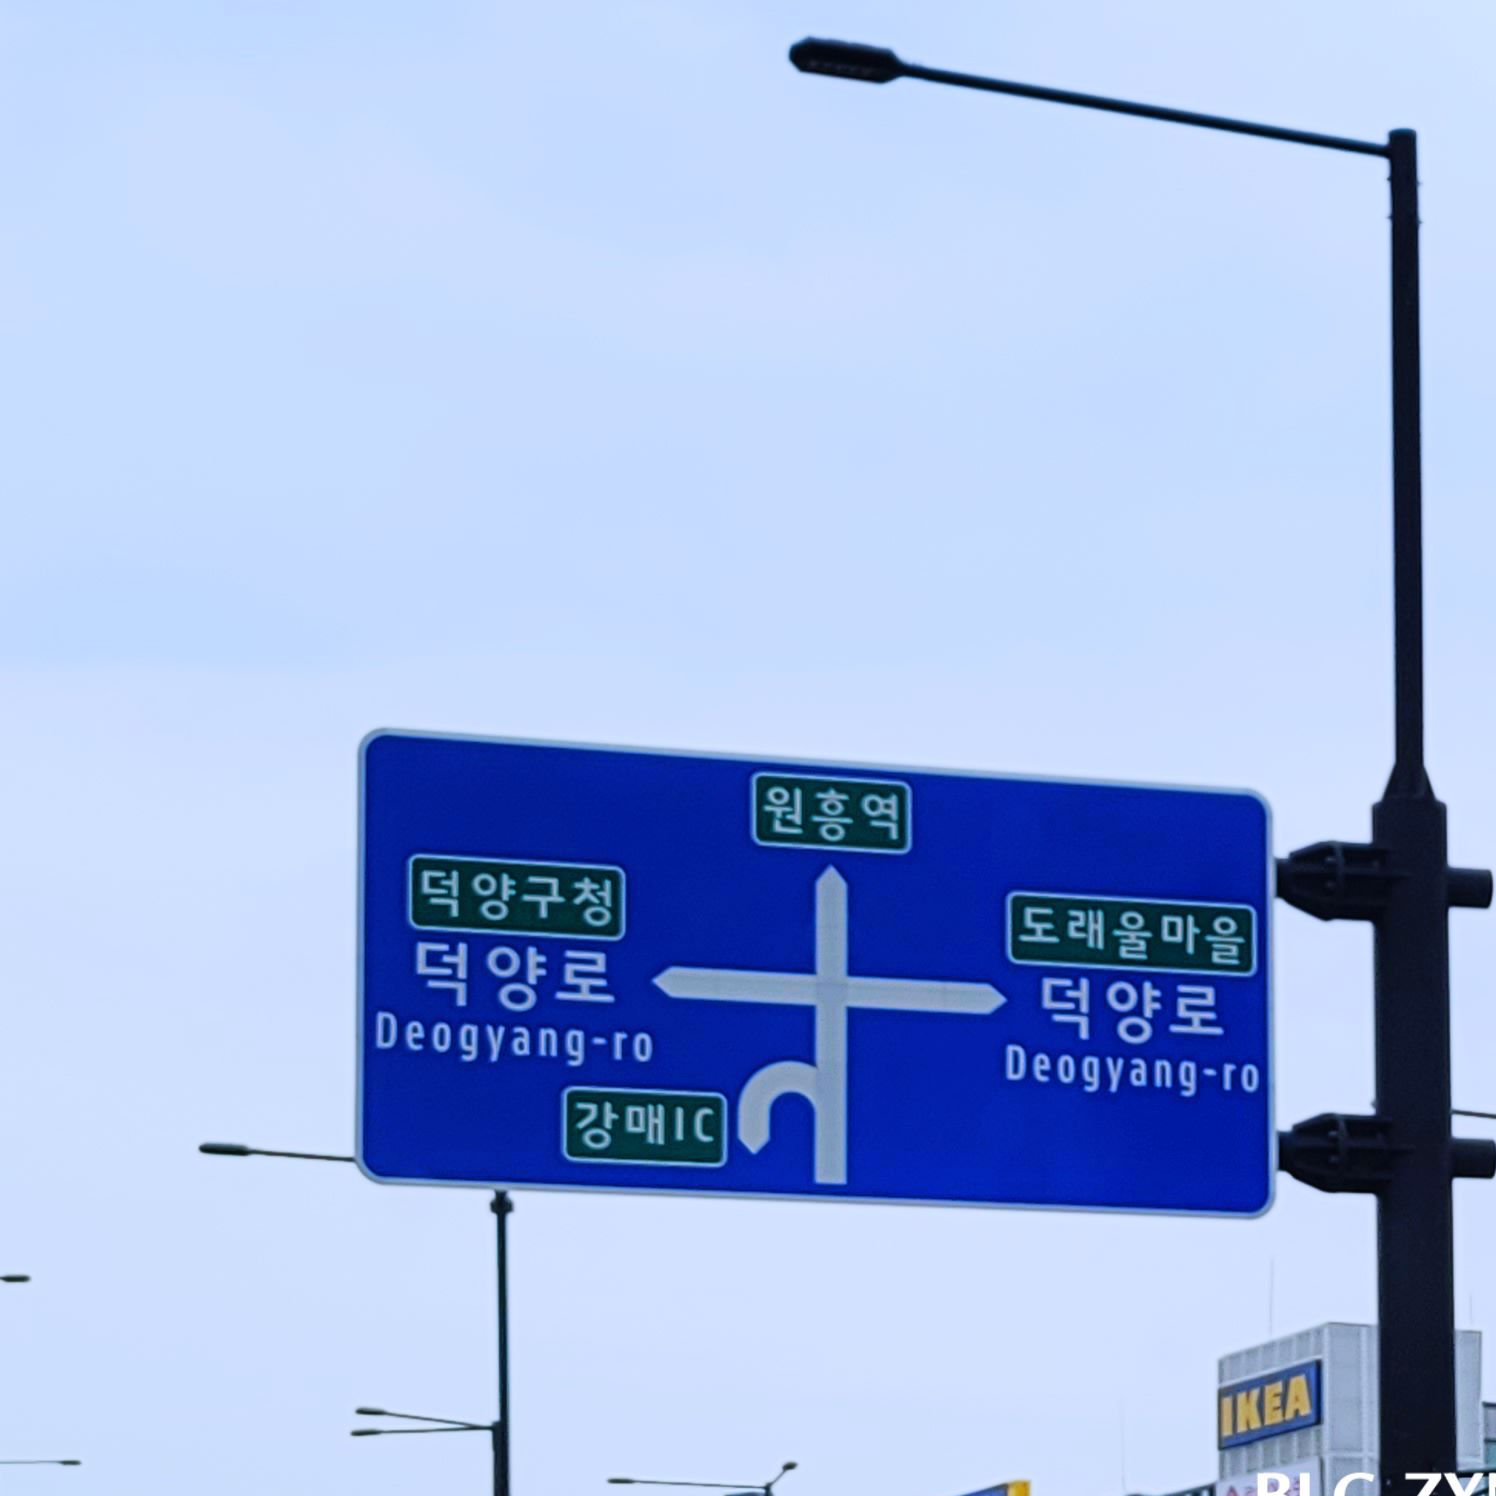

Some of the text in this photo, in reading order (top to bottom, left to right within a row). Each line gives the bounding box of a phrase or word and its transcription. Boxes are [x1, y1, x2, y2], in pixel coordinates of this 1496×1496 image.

[763, 784, 901, 843] 원흥역
[420, 868, 616, 929] 덕양구청
[1018, 904, 1247, 967] 도래울마을
[415, 940, 617, 1012] 덕양로
[376, 1012, 653, 1067] Deogyang-ro
[1041, 976, 1226, 1045] 덕양로
[1006, 1044, 1260, 1097] Deogyang-ro
[575, 1099, 716, 1151] 강매IC
[1221, 1373, 1311, 1437] IKEA
